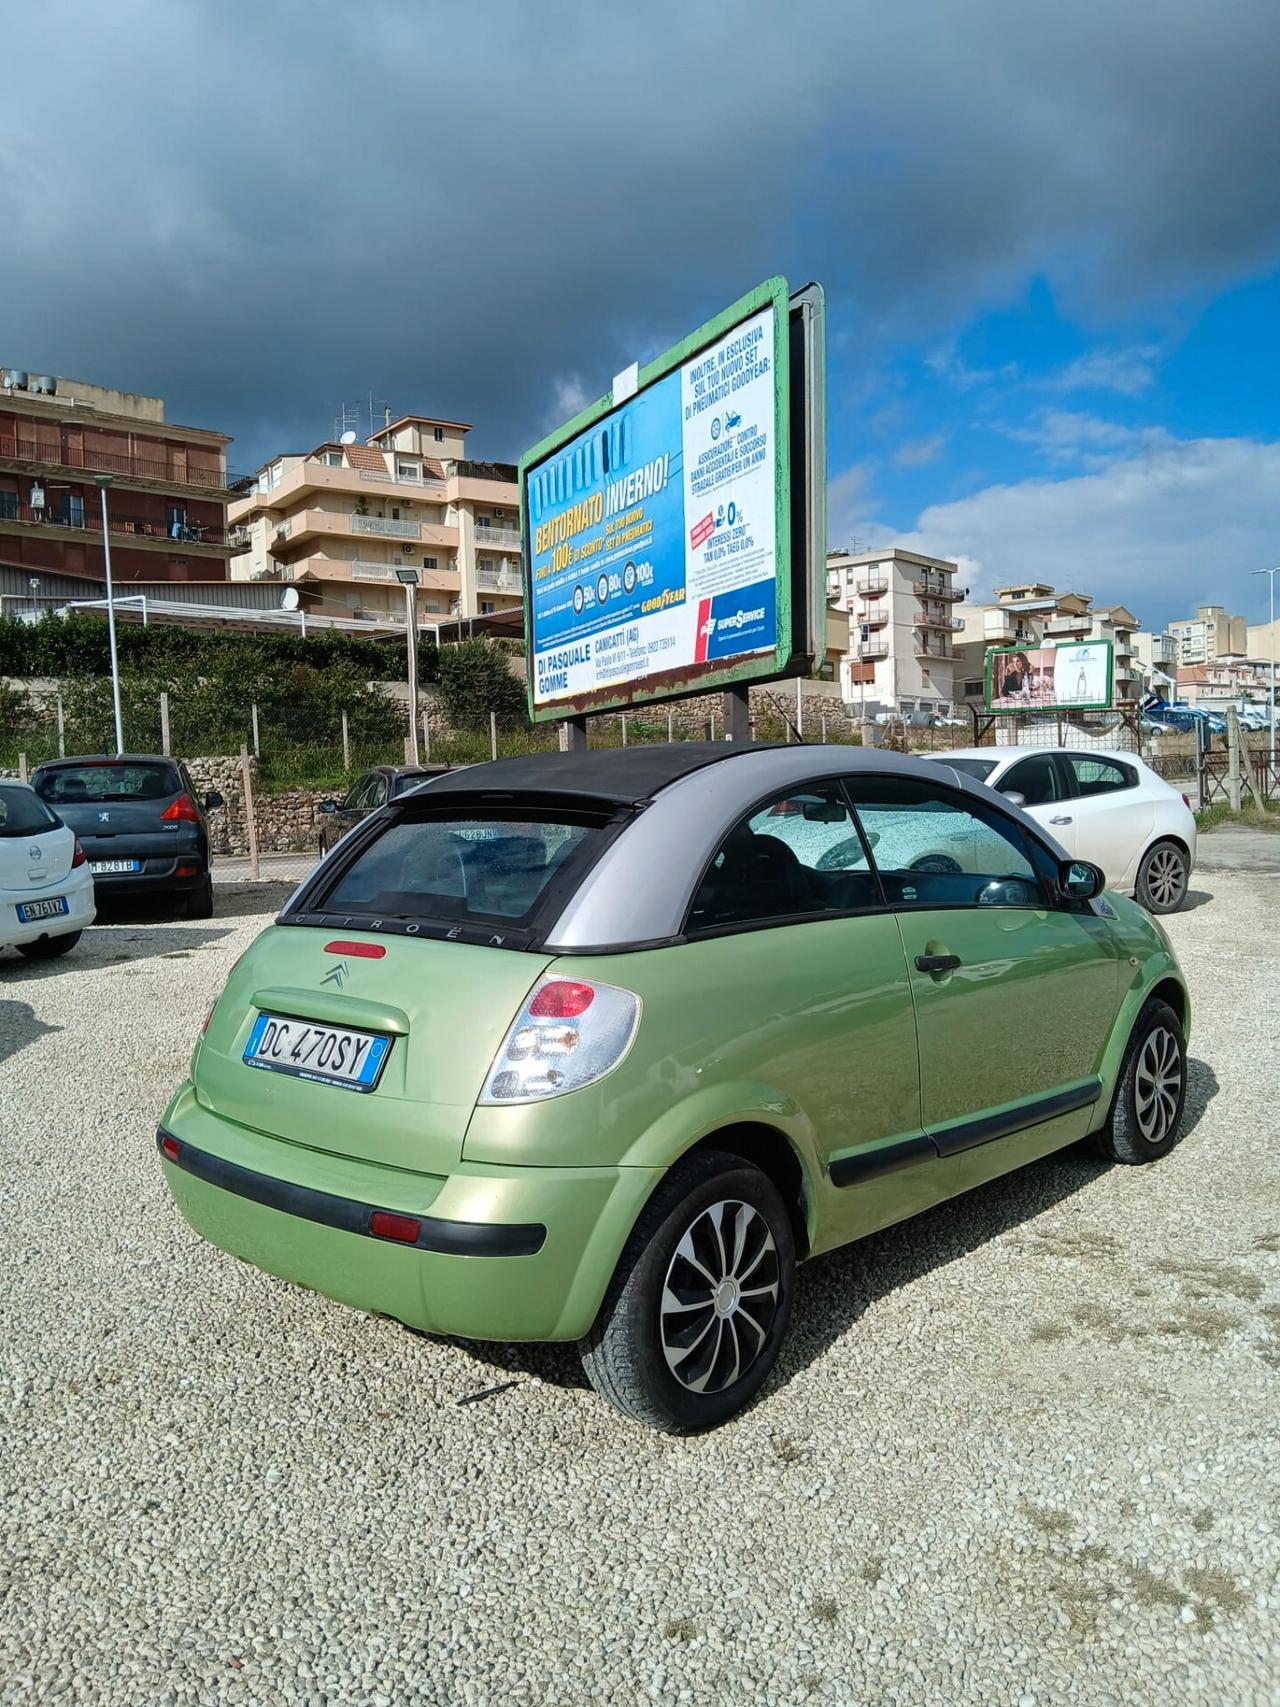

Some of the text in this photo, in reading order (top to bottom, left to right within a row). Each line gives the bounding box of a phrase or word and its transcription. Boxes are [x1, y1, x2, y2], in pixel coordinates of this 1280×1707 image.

[718, 350, 724, 365] IN
[726, 325, 763, 360] ESCLUSIVA
[685, 356, 770, 420] DI PNEUMATICI GOODYEAR:
[694, 346, 757, 398] SUL TUO NUOVO SET
[535, 491, 603, 556] BENTORNATO
[606, 452, 670, 517] INVERNO!
[640, 588, 686, 612] GOODYEAR
[538, 644, 591, 675] DI PASQUALE
[539, 672, 568, 694] GOMME
[101, 860, 132, 871] 828TB
[23, 899, 63, 918] EN 761VZ
[259, 1022, 369, 1075] DC 470SY
